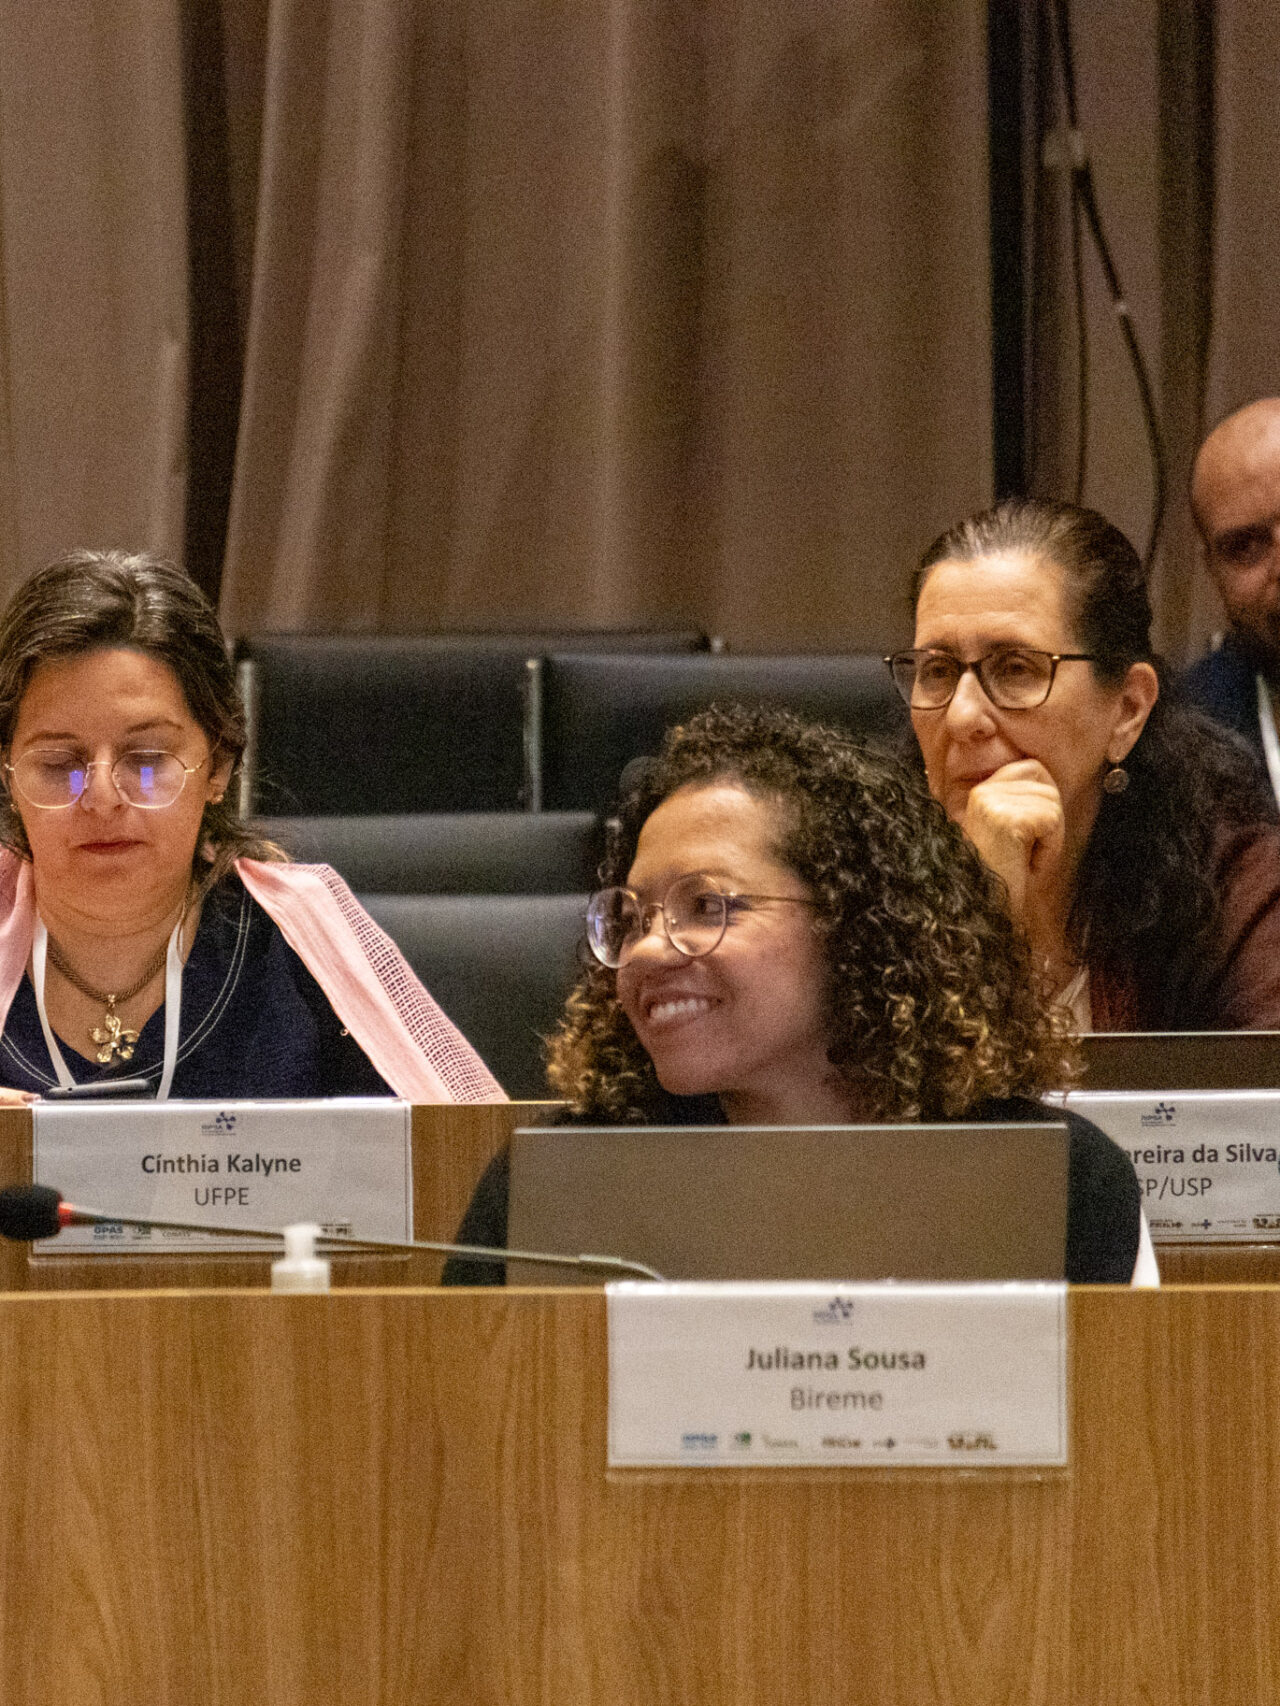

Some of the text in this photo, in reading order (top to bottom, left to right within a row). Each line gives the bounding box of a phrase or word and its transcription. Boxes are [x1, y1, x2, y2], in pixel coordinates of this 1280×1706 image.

[1192, 1143, 1219, 1163] da
[1226, 1143, 1277, 1162] Silva
[142, 1152, 302, 1178] Cínthia Kalyne
[194, 1187, 250, 1206] UFPE
[746, 1345, 926, 1370] Juliana Sousa
[790, 1388, 884, 1411] Bireme
